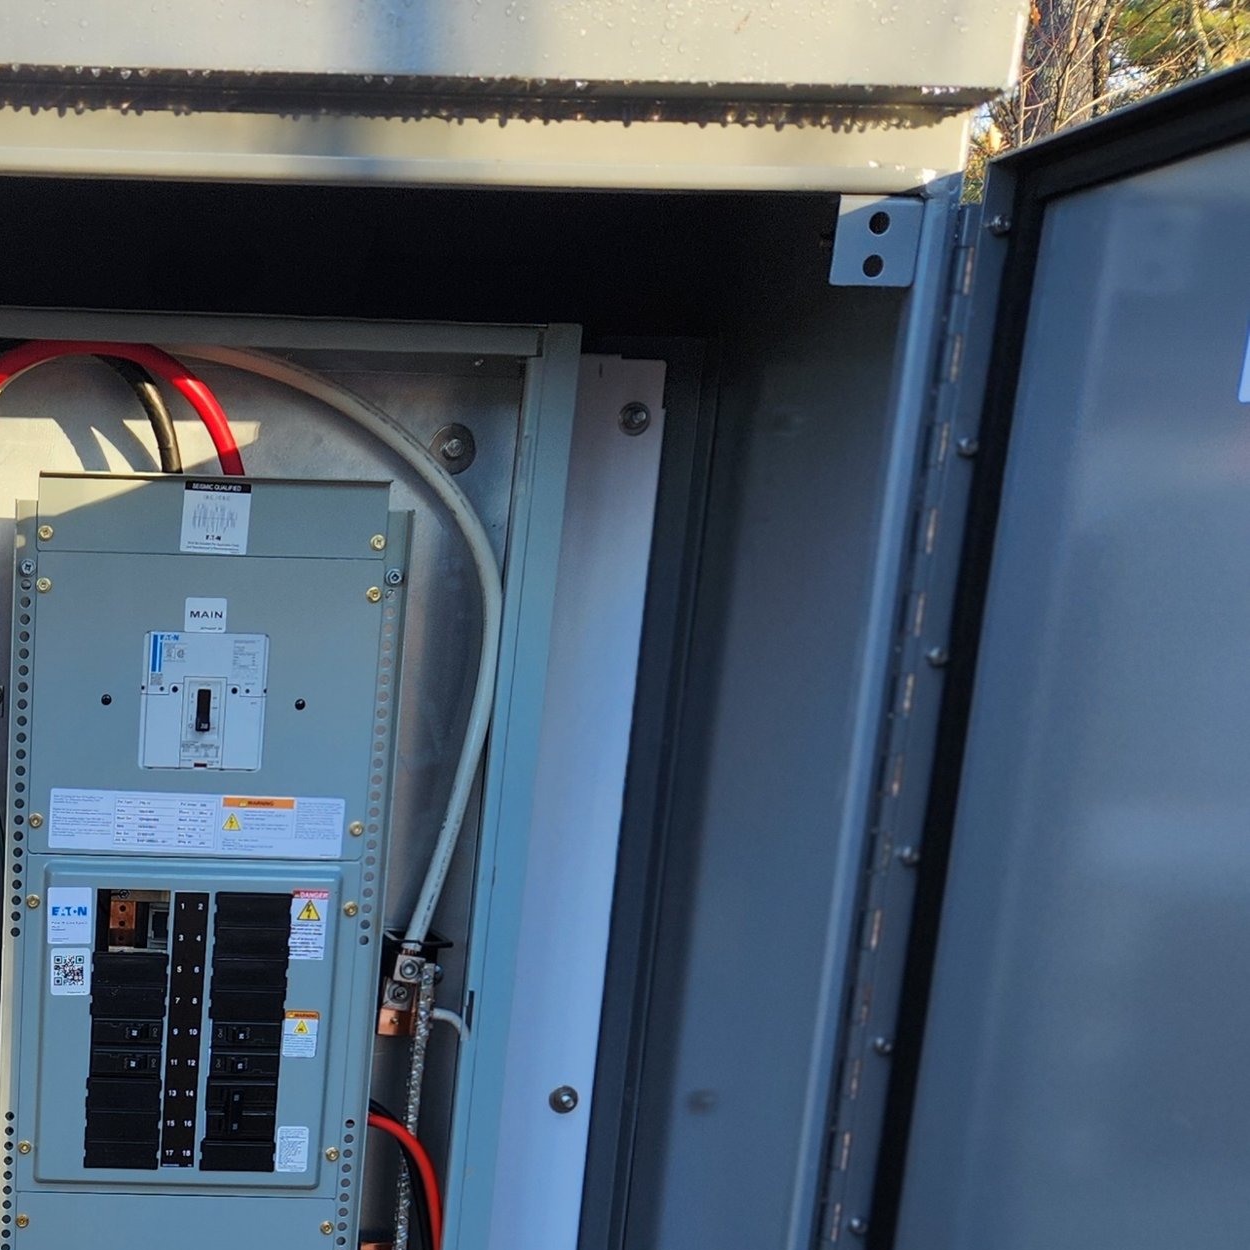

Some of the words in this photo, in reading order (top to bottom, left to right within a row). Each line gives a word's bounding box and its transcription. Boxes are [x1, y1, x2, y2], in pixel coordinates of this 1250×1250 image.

[189, 610, 223, 619] MAIN
[192, 997, 197, 1005] 8
[182, 1149, 191, 1157] 18
